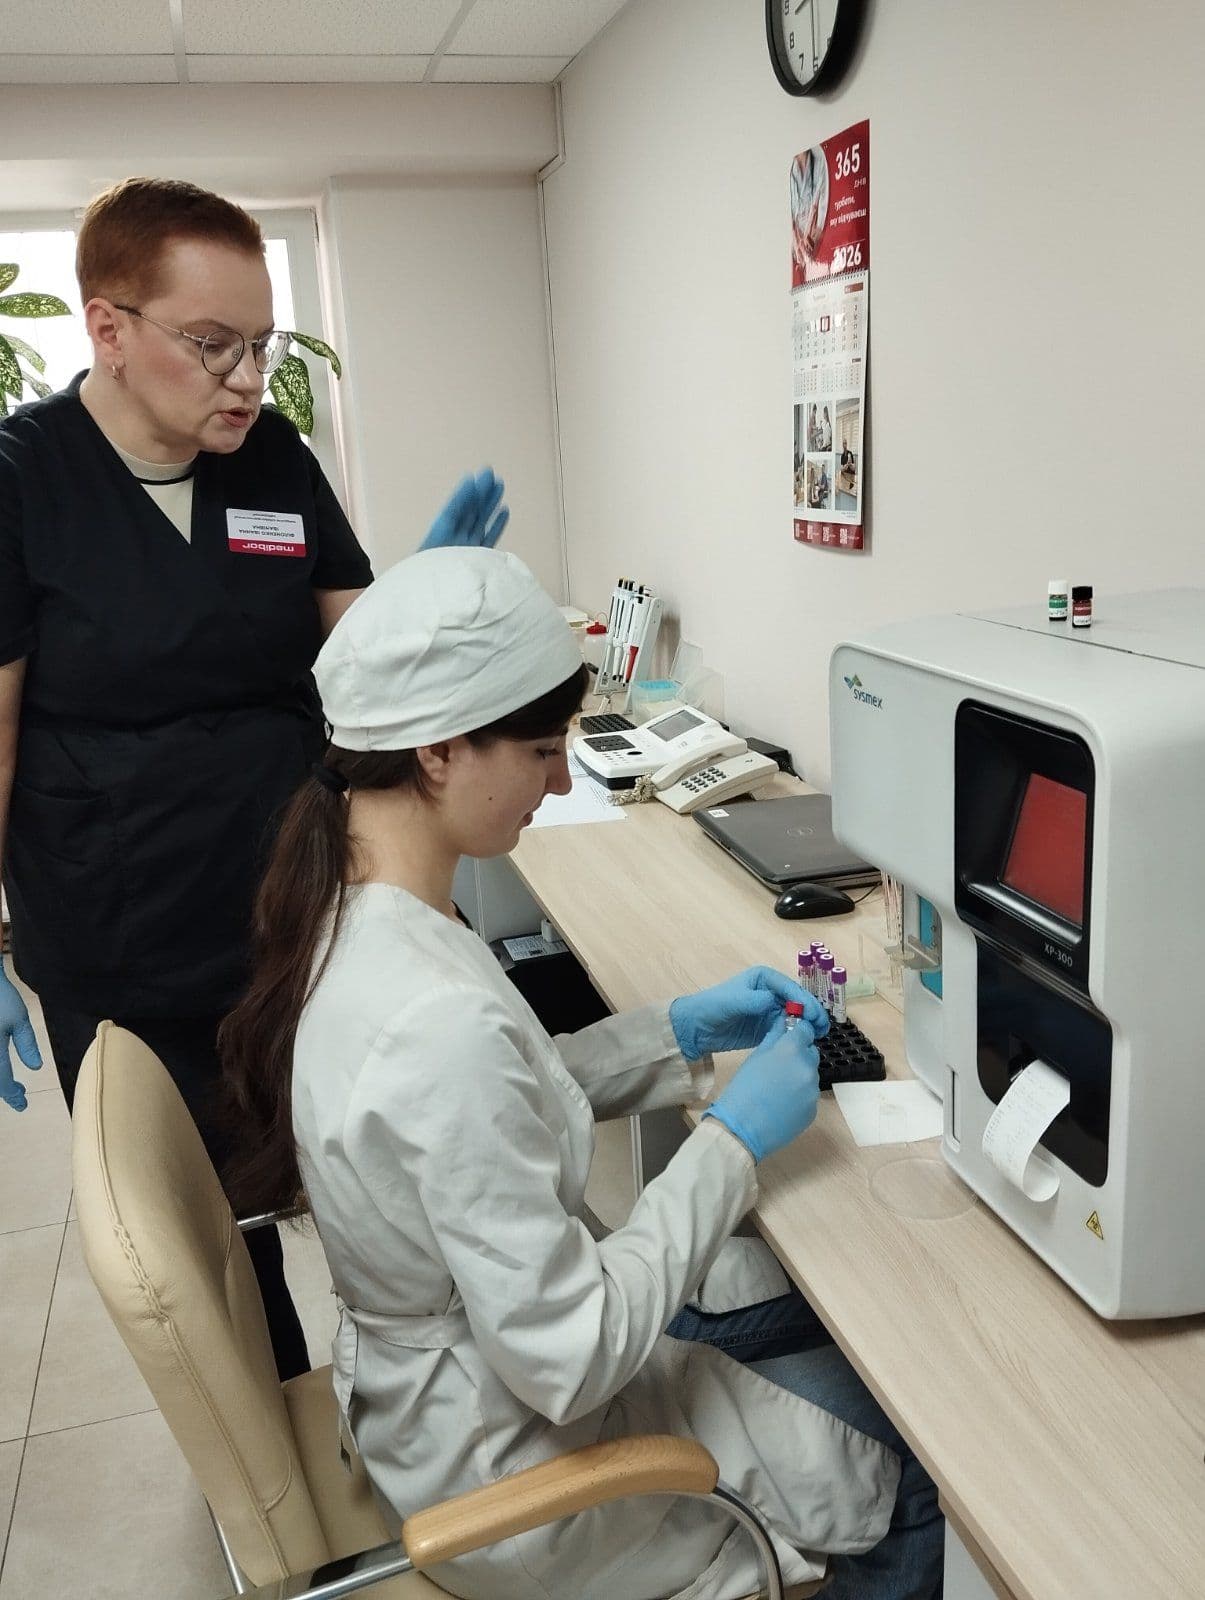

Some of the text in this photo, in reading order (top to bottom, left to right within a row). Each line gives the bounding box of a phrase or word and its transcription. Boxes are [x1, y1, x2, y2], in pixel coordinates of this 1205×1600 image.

[784, 0, 789, 15] 9
[789, 32, 794, 49] 8
[799, 53, 804, 70] 7
[835, 143, 860, 181] 365
[832, 243, 862, 271] 2026
[853, 688, 883, 710] sysmex
[1044, 941, 1073, 968] XP-300
